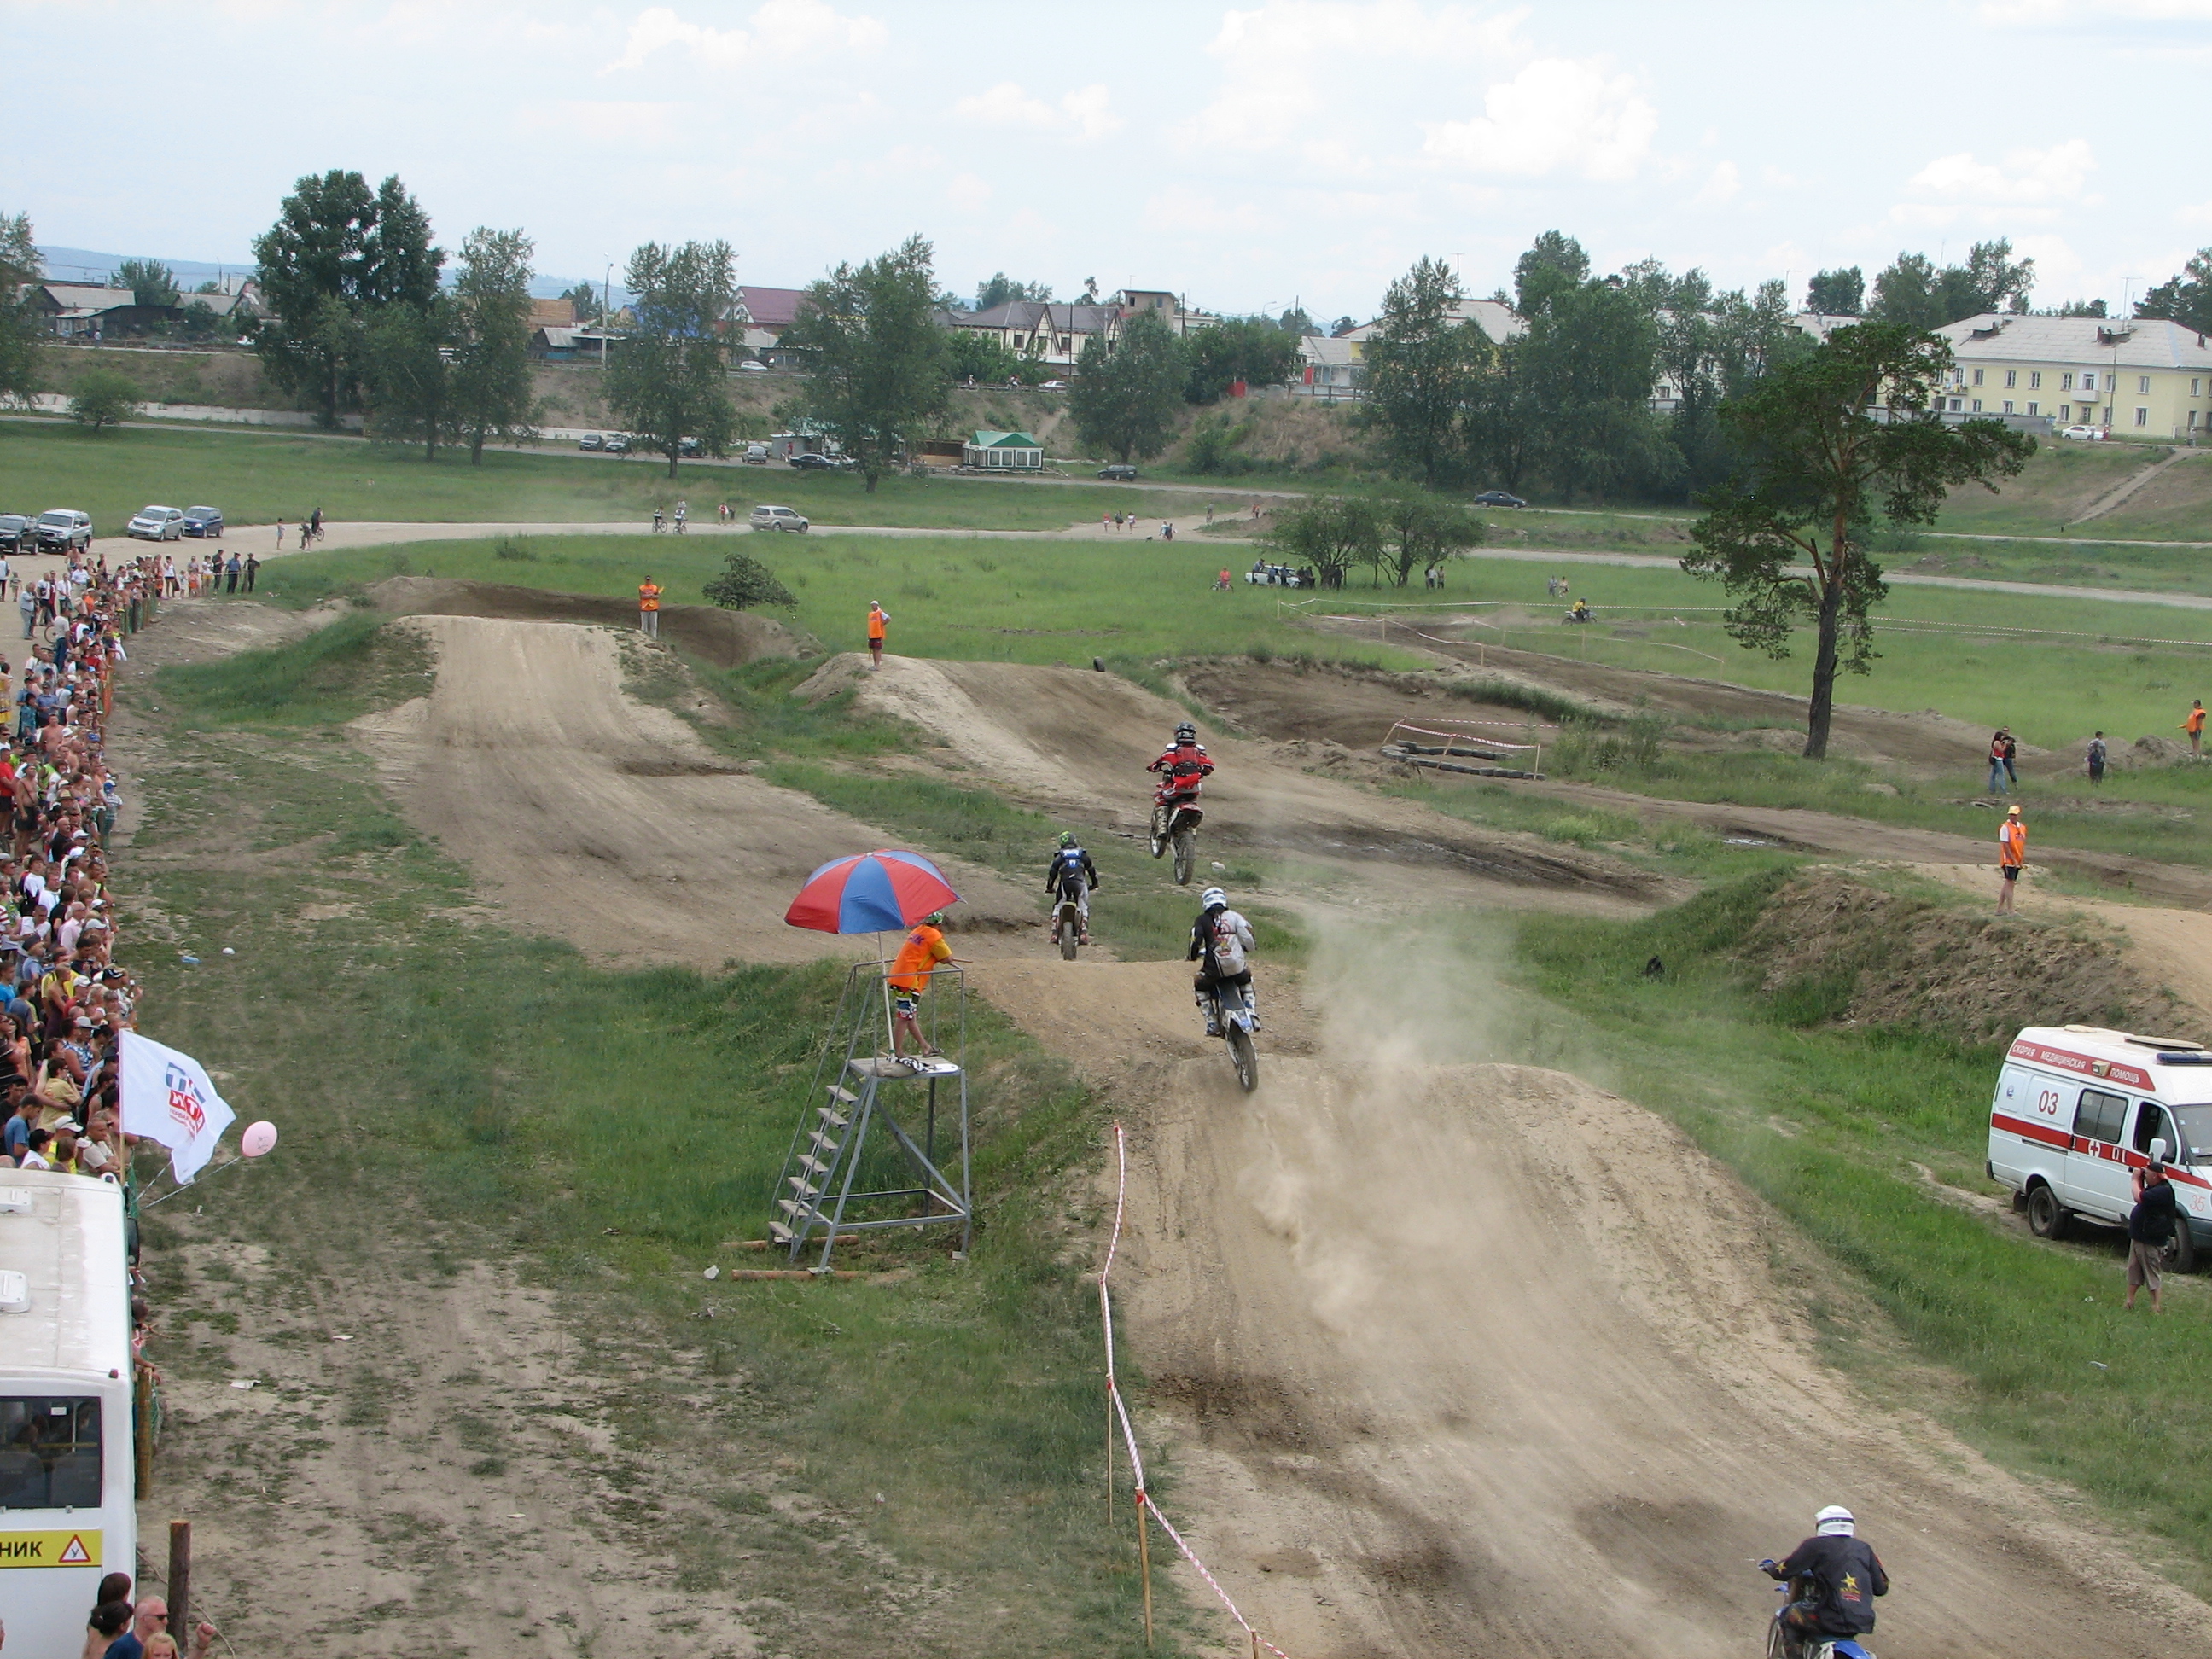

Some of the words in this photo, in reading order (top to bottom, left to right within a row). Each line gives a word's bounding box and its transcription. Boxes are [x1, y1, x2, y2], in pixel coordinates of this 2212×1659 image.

[2012, 1045, 2036, 1057] СКОРАЯ
[2040, 1051, 2087, 1069] МЕДИЦИНСКАЯ
[2110, 1067, 2140, 1084] ПОМОЩЬ
[2038, 1089, 2059, 1115] 03
[2189, 1194, 2206, 1212] 35
[0, 1541, 43, 1558] НИК
